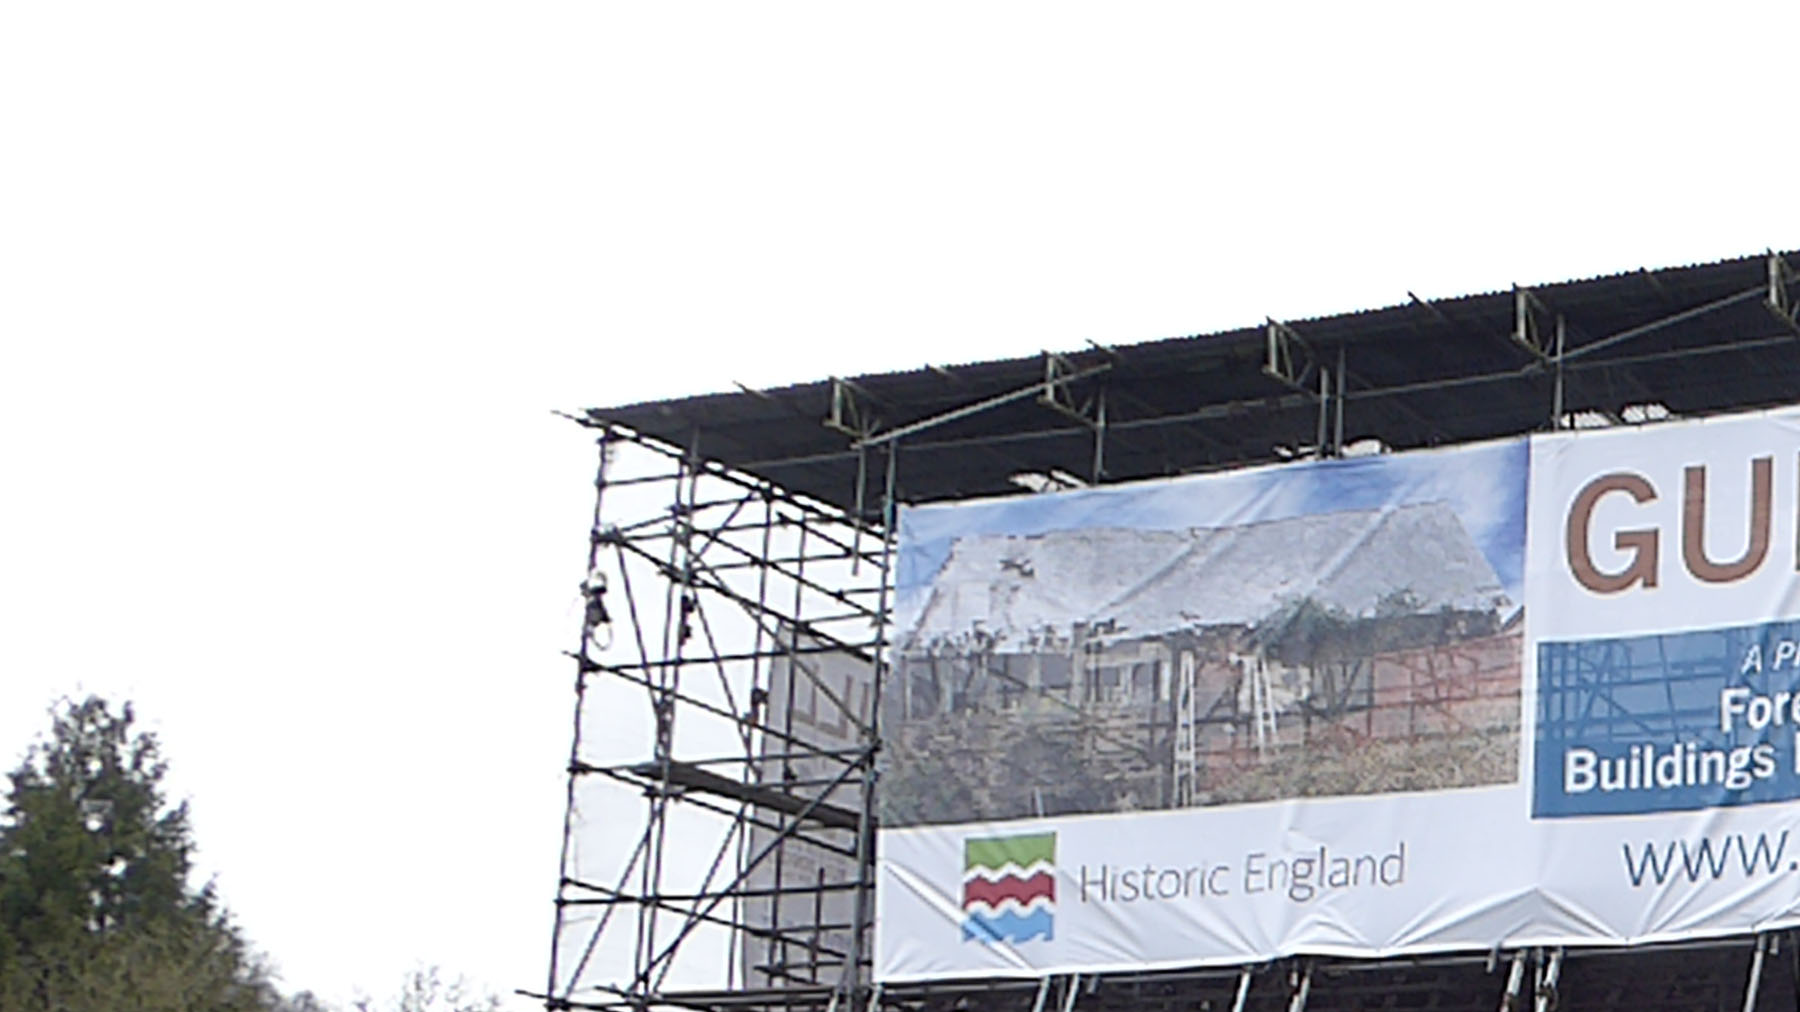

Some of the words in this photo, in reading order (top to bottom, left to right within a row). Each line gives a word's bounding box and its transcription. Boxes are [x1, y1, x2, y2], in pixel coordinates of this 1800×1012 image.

[1742, 646, 1762, 674] A
[1563, 738, 1776, 794] Buildings
[1080, 864, 1230, 903] Historic
[1244, 842, 1406, 901] England
